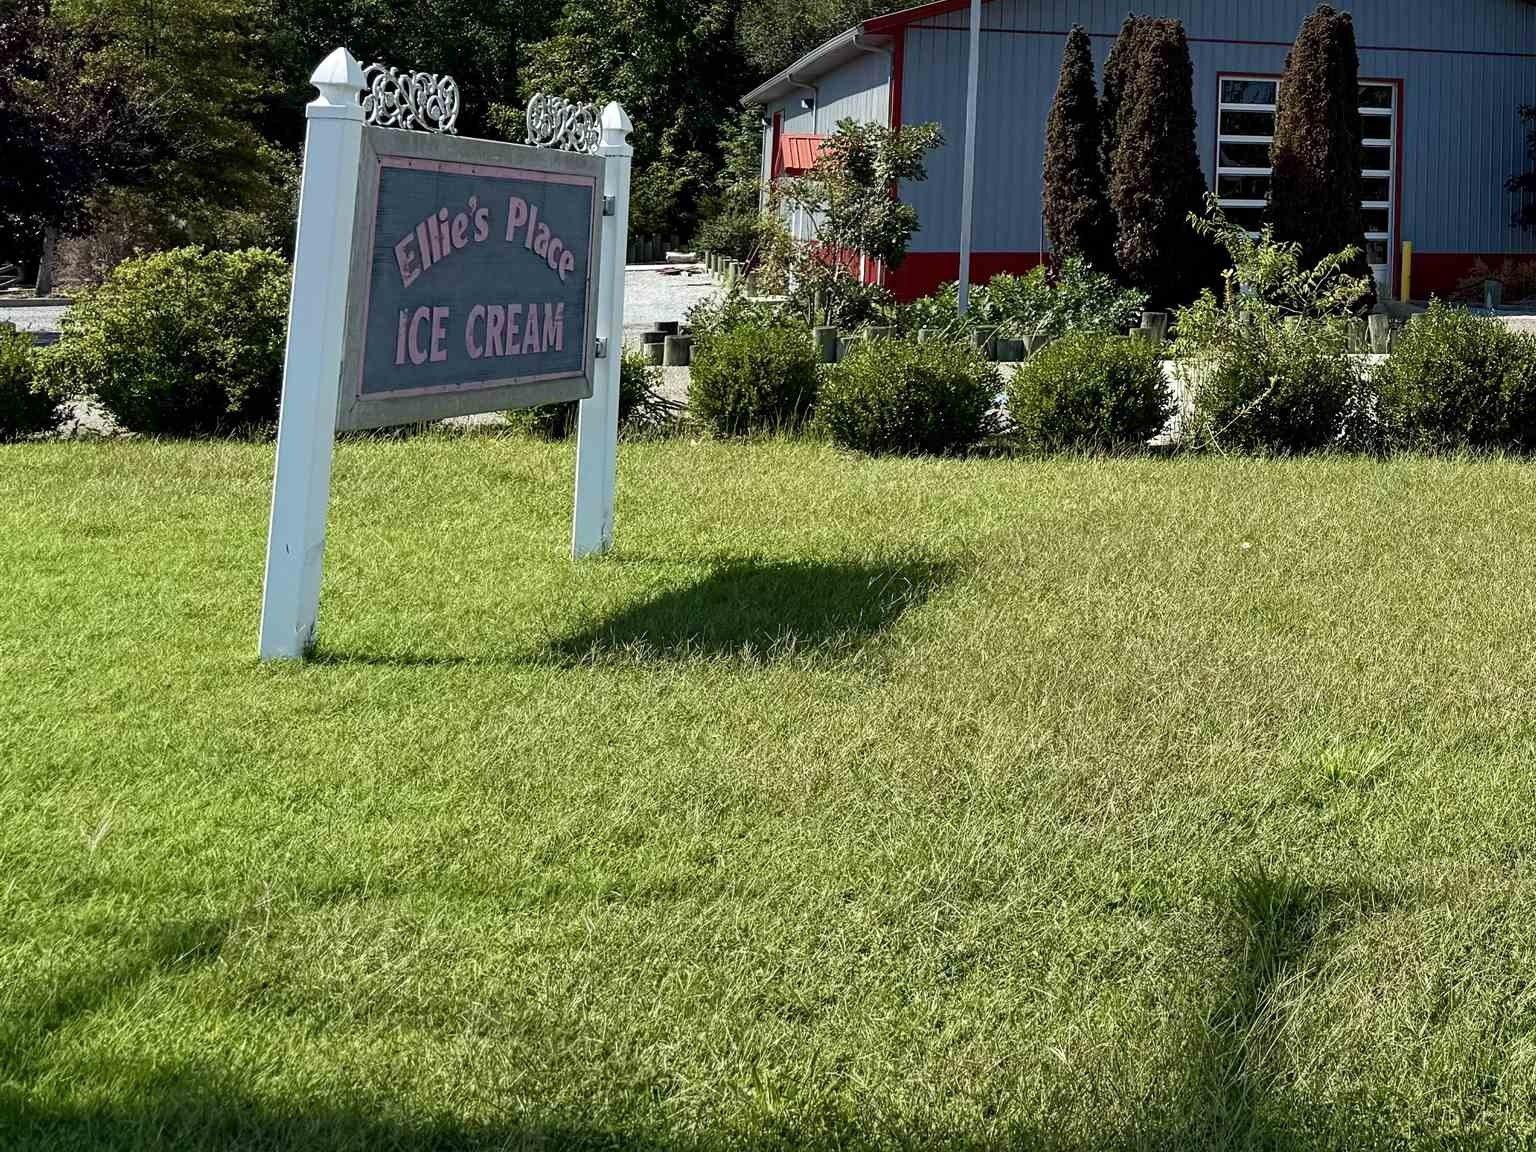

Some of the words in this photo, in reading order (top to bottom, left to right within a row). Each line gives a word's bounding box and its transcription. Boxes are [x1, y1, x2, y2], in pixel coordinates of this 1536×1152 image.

[393, 195, 489, 289] Ellie's
[505, 196, 575, 281] Place
[395, 305, 450, 366] ICE
[465, 302, 565, 360] CREAM
